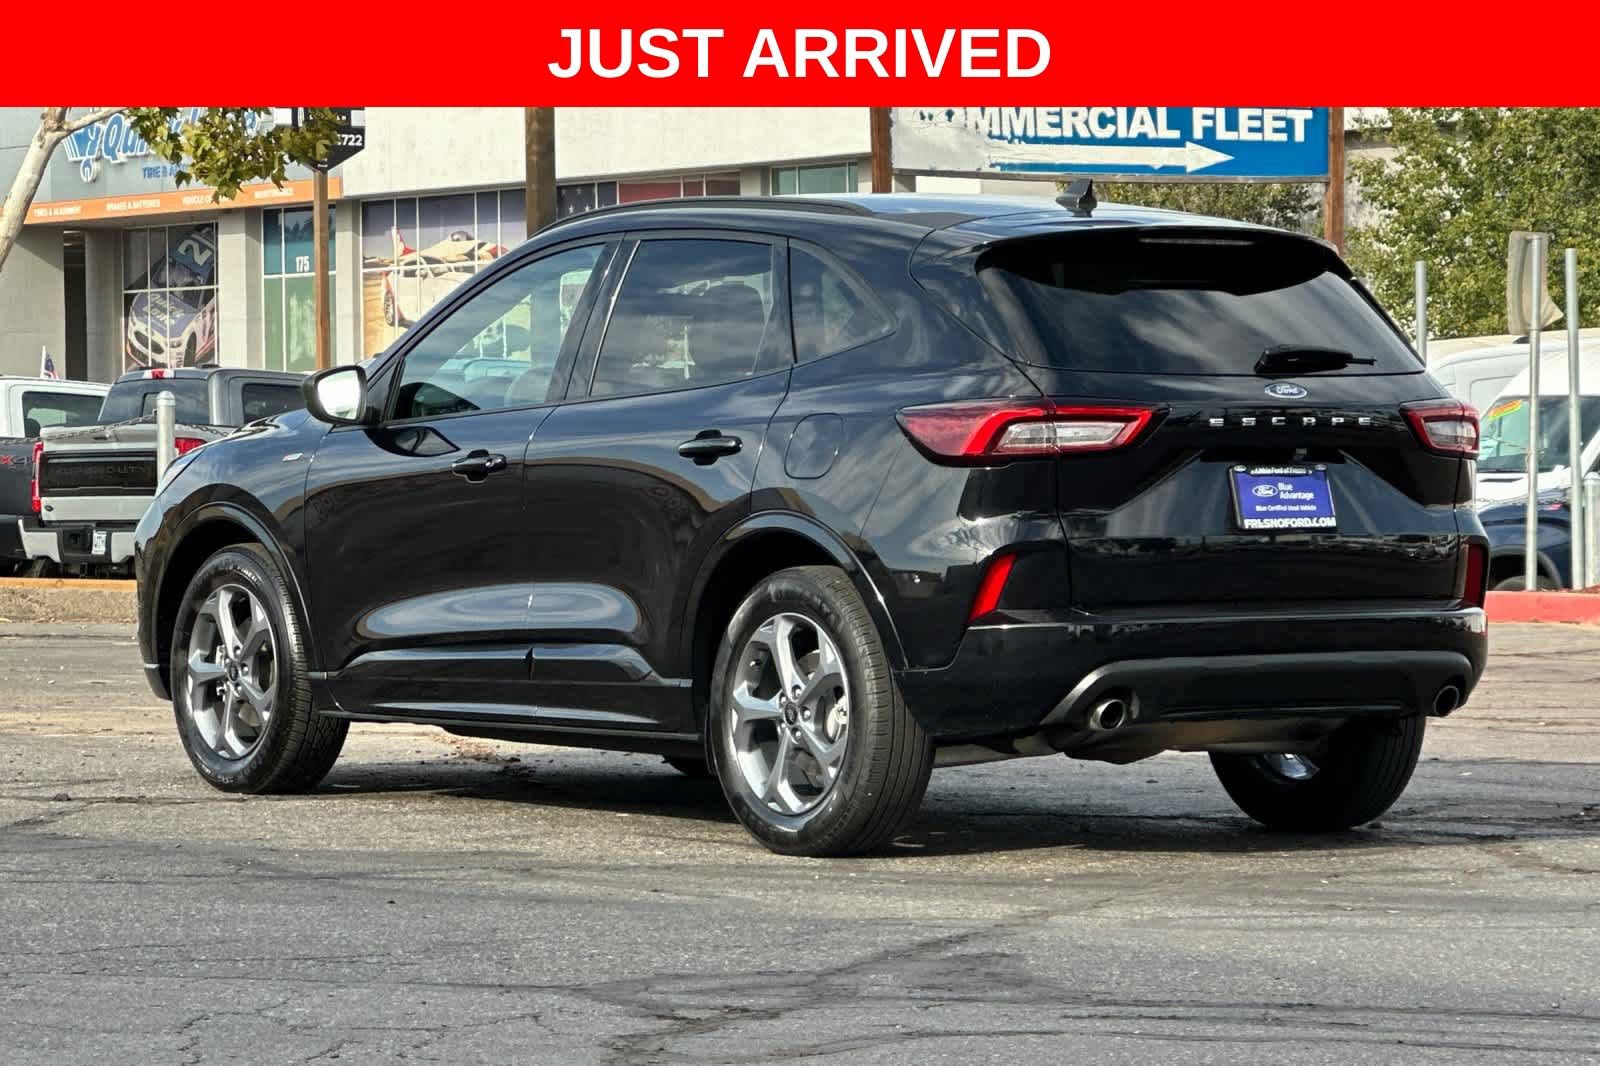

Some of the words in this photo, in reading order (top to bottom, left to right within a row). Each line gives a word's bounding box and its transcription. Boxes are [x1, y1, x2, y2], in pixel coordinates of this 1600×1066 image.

[914, 106, 1181, 139] MMERCIAL
[1192, 107, 1314, 142] FLEET
[337, 133, 363, 147] 722
[295, 256, 310, 273] 175
[1209, 416, 1372, 427] ESCAPE
[1277, 482, 1293, 491] Blue
[1280, 491, 1315, 501] Advantage
